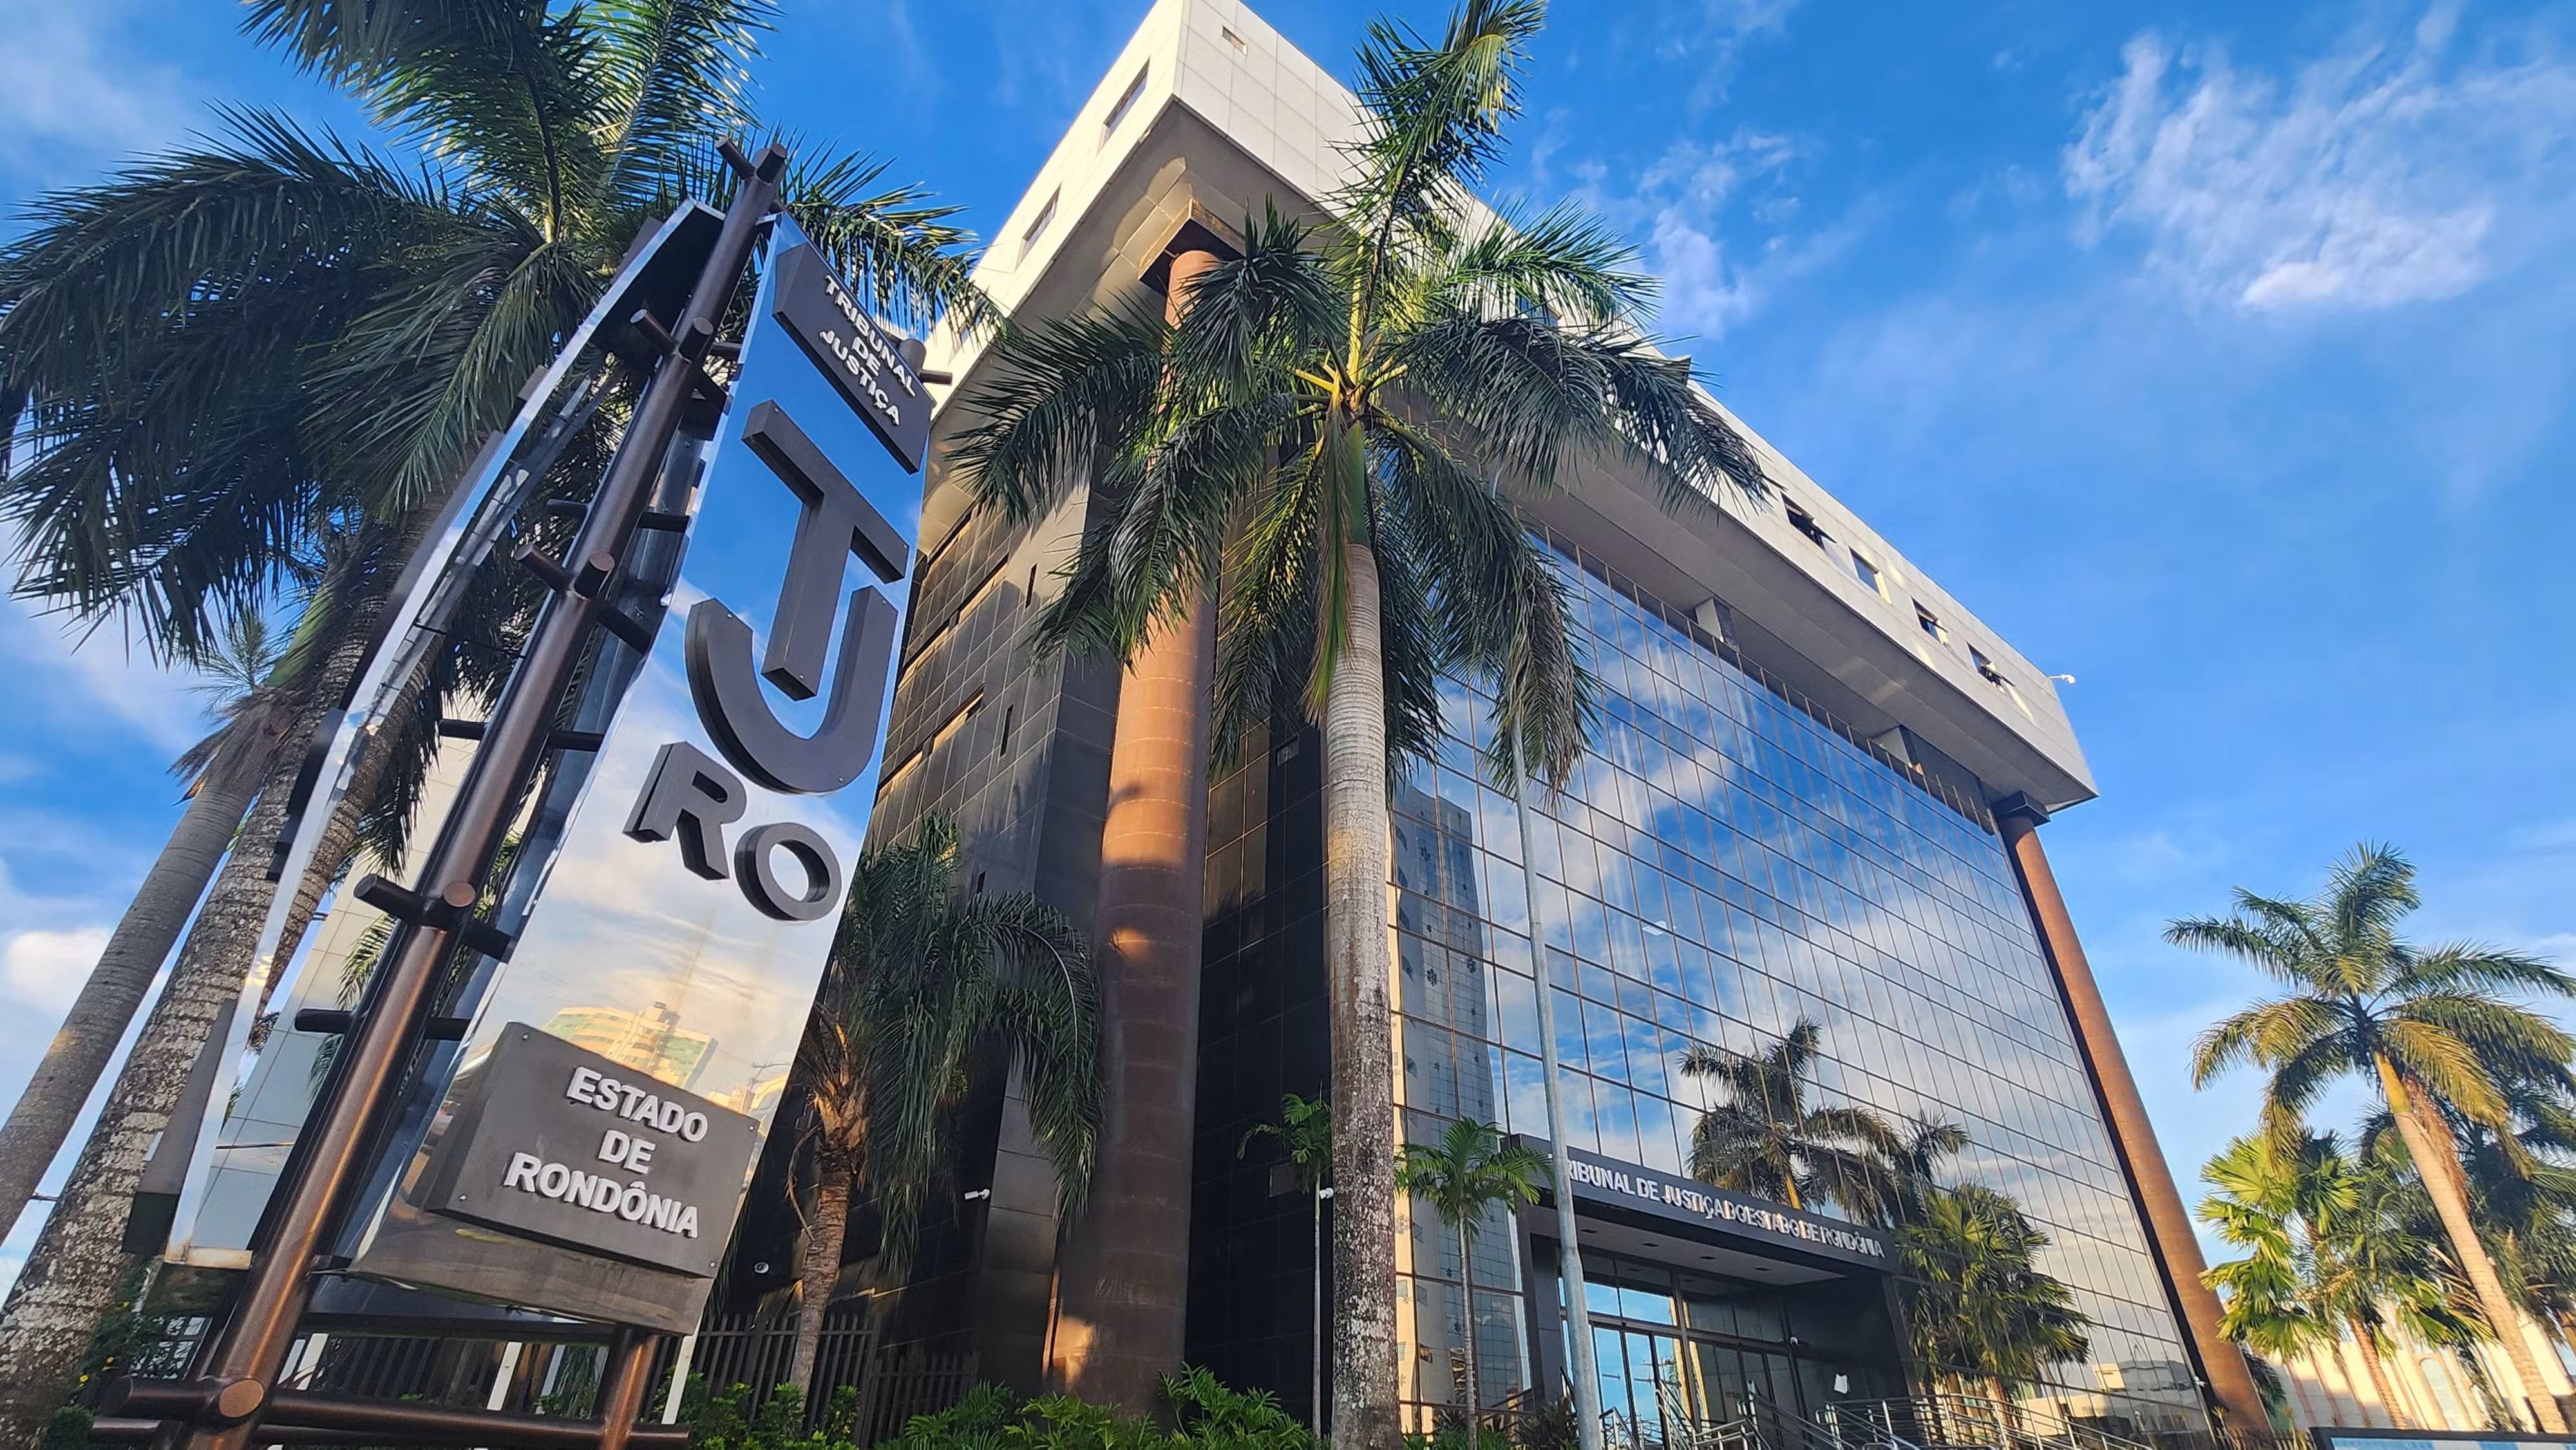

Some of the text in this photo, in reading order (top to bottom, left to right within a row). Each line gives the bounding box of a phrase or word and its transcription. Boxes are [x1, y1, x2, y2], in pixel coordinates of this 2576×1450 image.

[819, 330, 900, 426] JUSTIÇA
[825, 275, 916, 397] TRIBUNAL
[851, 336, 880, 377] DE
[622, 741, 842, 921] RO
[566, 1066, 708, 1142] ESTADO
[503, 1152, 699, 1238] RONDÔNIA
[598, 1130, 656, 1174] DE
[1548, 1153, 1886, 1258] RIBUNAL DE JUSTIÇA DO ESTADO DE RONDÔNIA
